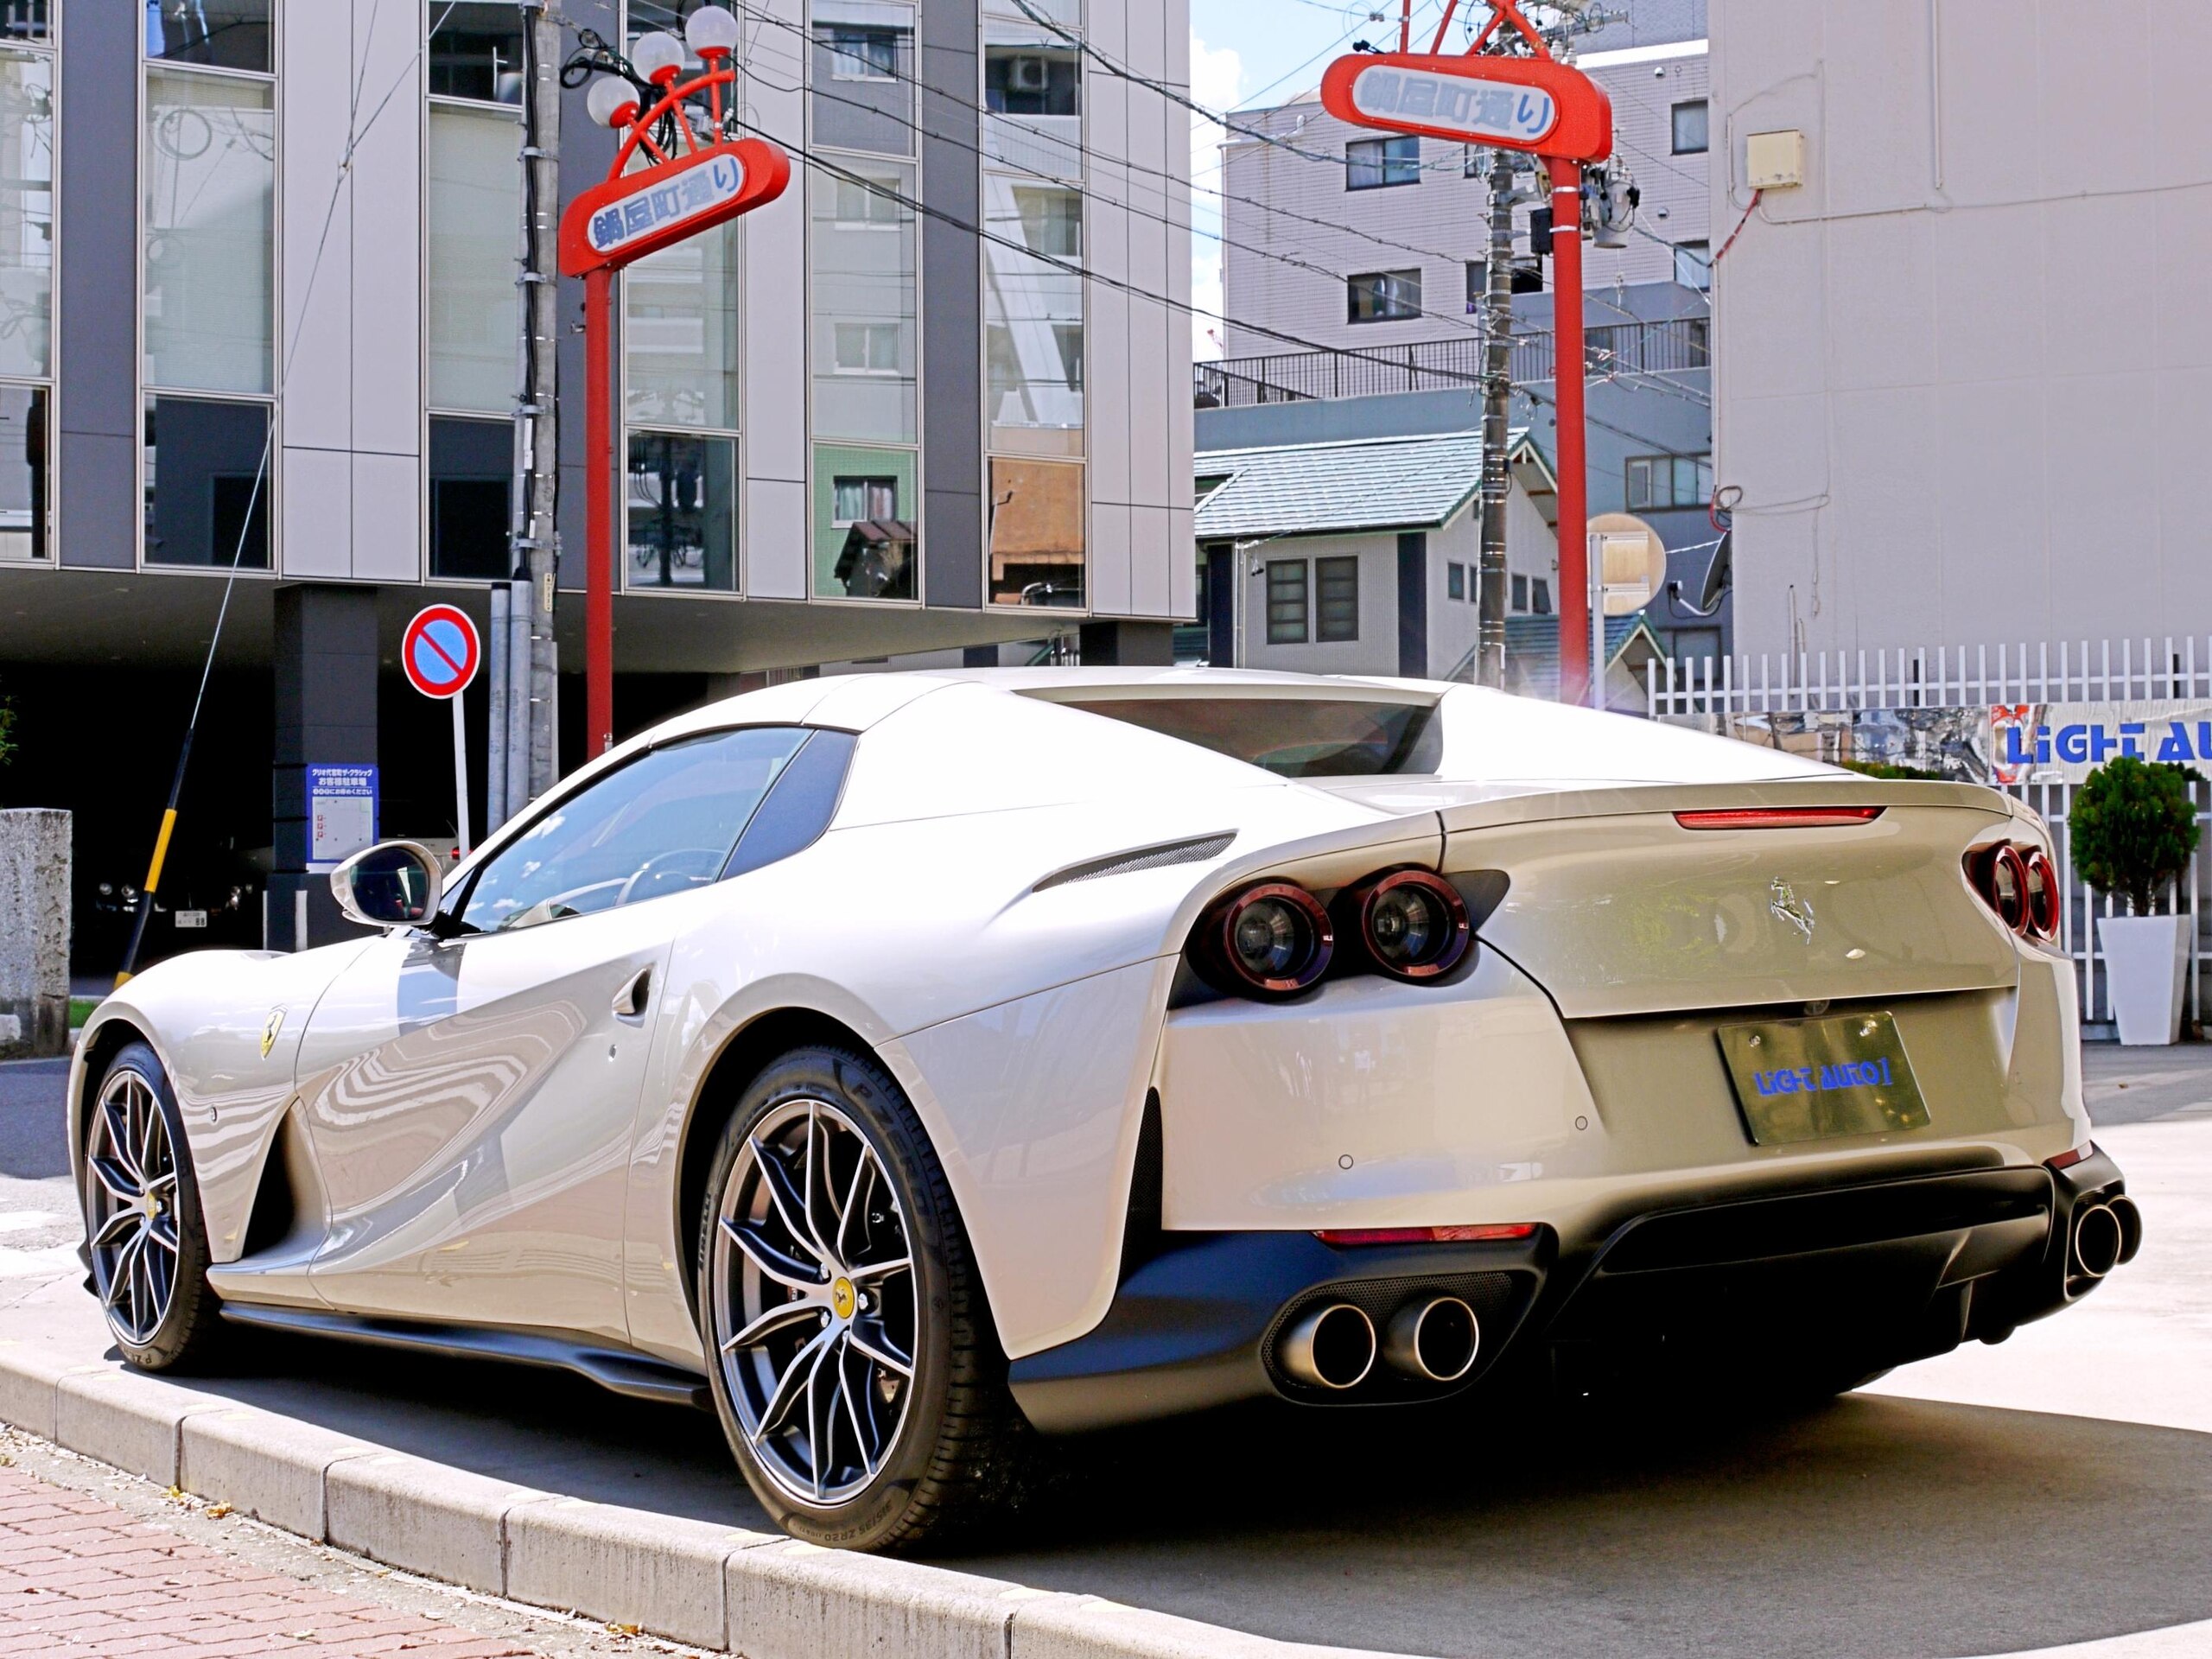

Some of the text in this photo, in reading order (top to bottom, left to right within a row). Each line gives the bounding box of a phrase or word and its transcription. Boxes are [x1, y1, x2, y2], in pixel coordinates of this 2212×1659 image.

[1359, 71, 1550, 134] 鍋屋町通り
[594, 157, 739, 250] 鍋屋町通り
[823, 1529, 856, 1541] ZR20
